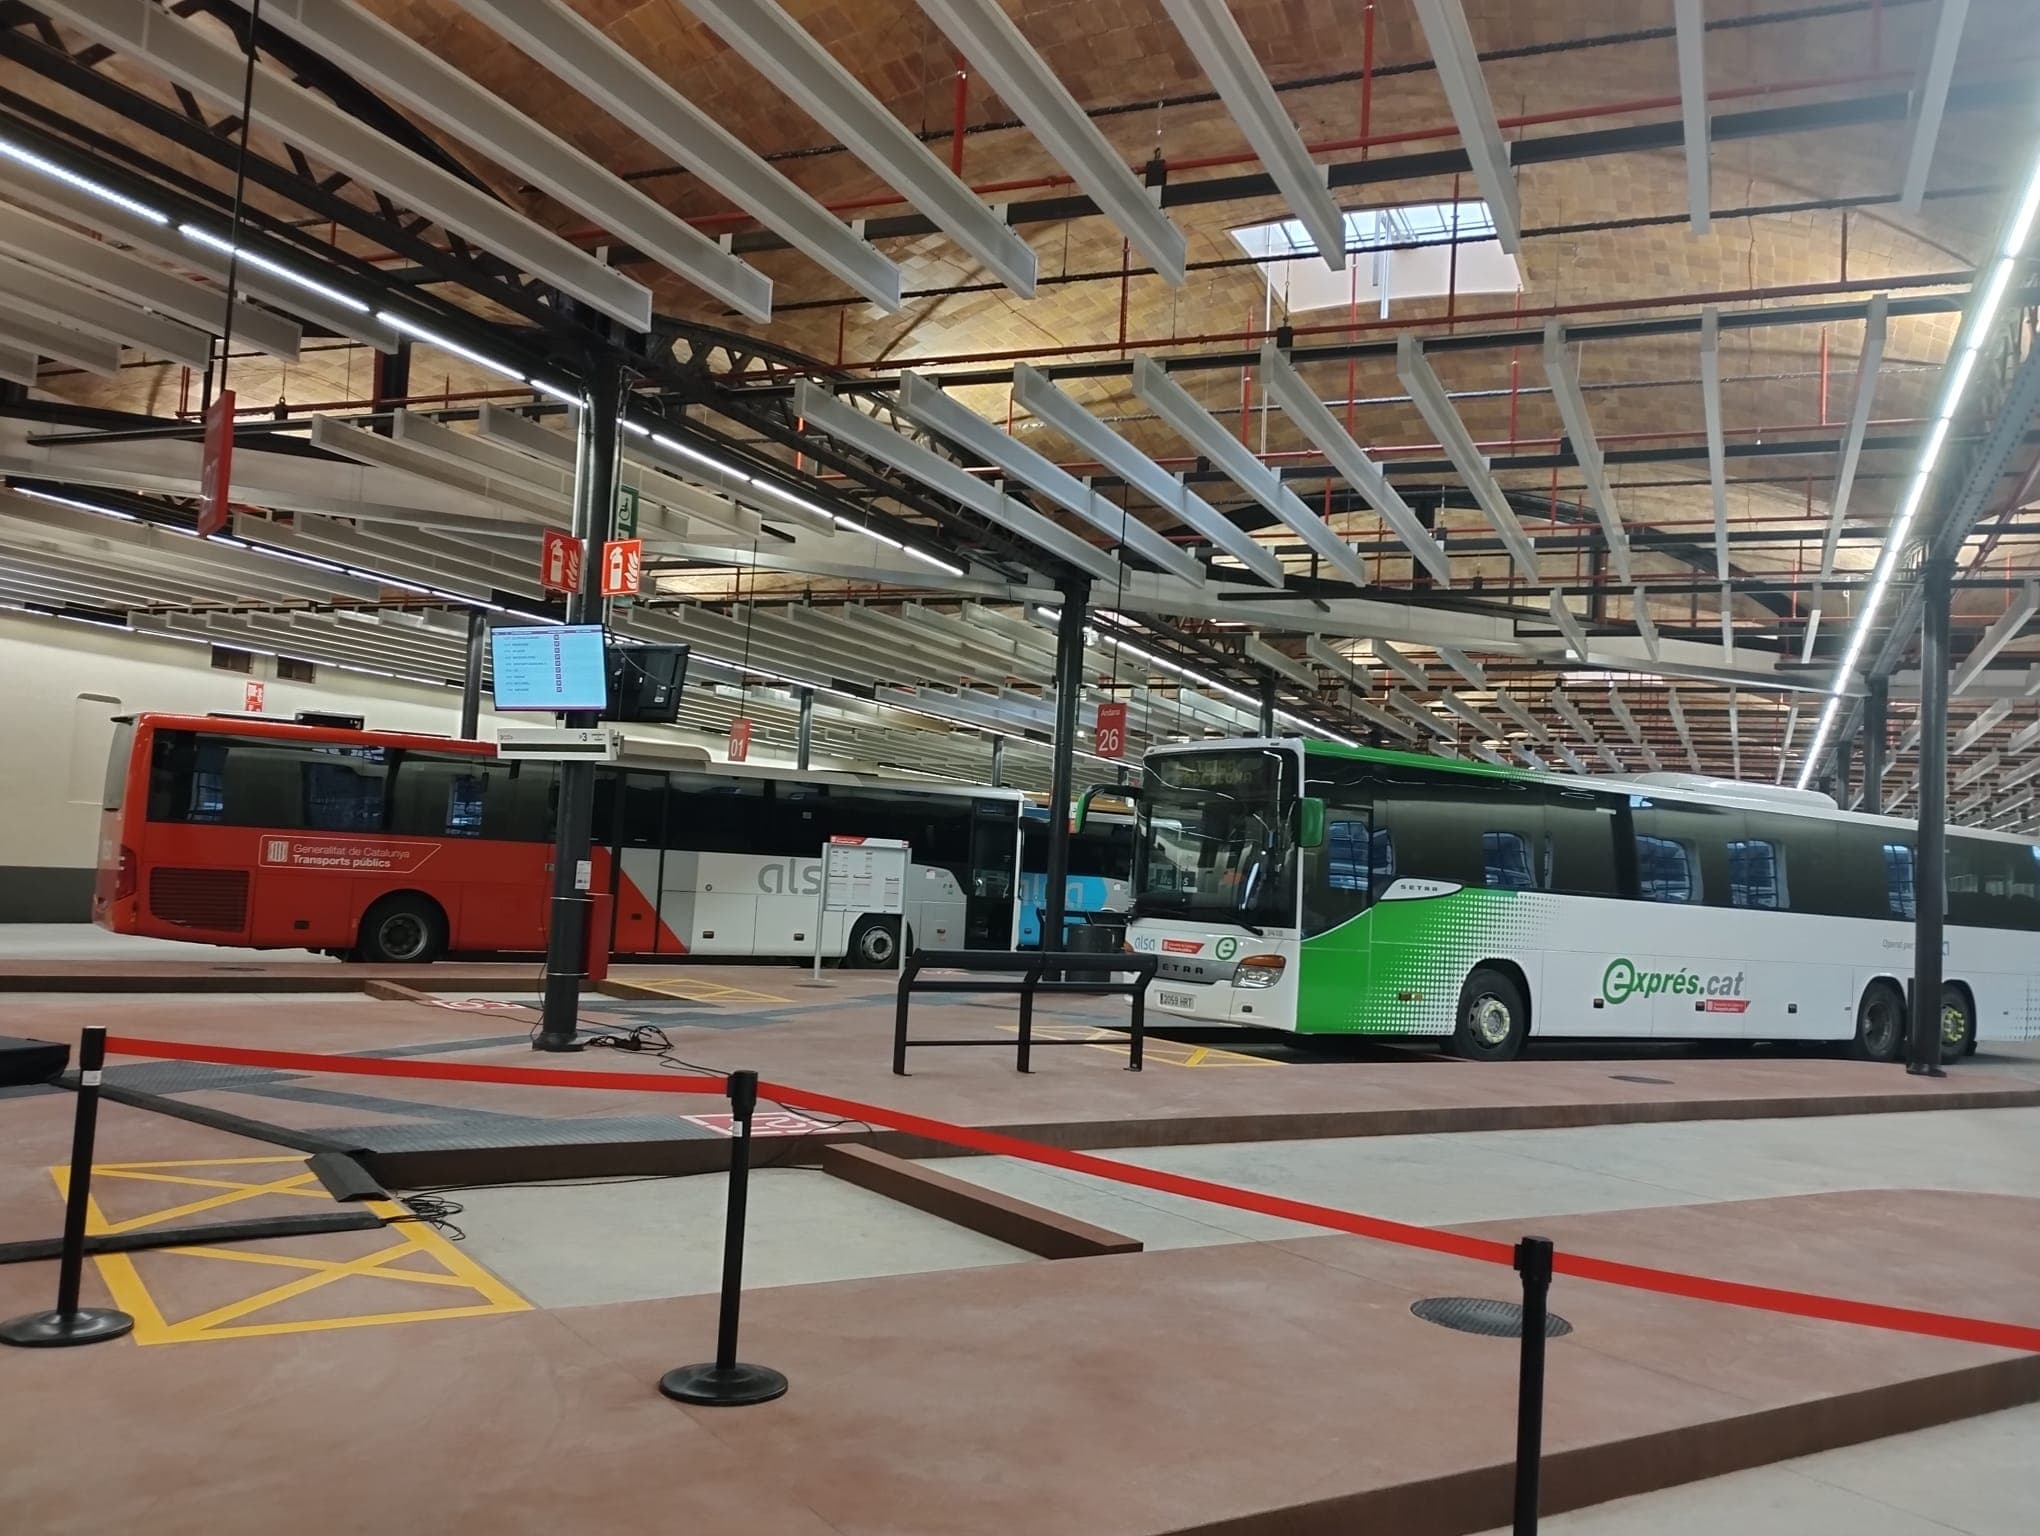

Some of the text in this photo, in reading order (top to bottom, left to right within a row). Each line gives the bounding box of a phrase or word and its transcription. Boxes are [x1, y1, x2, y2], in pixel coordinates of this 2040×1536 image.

[730, 739, 744, 757] 01
[1099, 728, 1119, 752] 26
[293, 843, 410, 860] Generalitat de Catalunya
[293, 854, 391, 868] Transports públics
[758, 858, 823, 895] als
[1400, 884, 1438, 892] SETRA
[1134, 935, 1155, 951] alsa
[1162, 962, 1204, 975] ETRA
